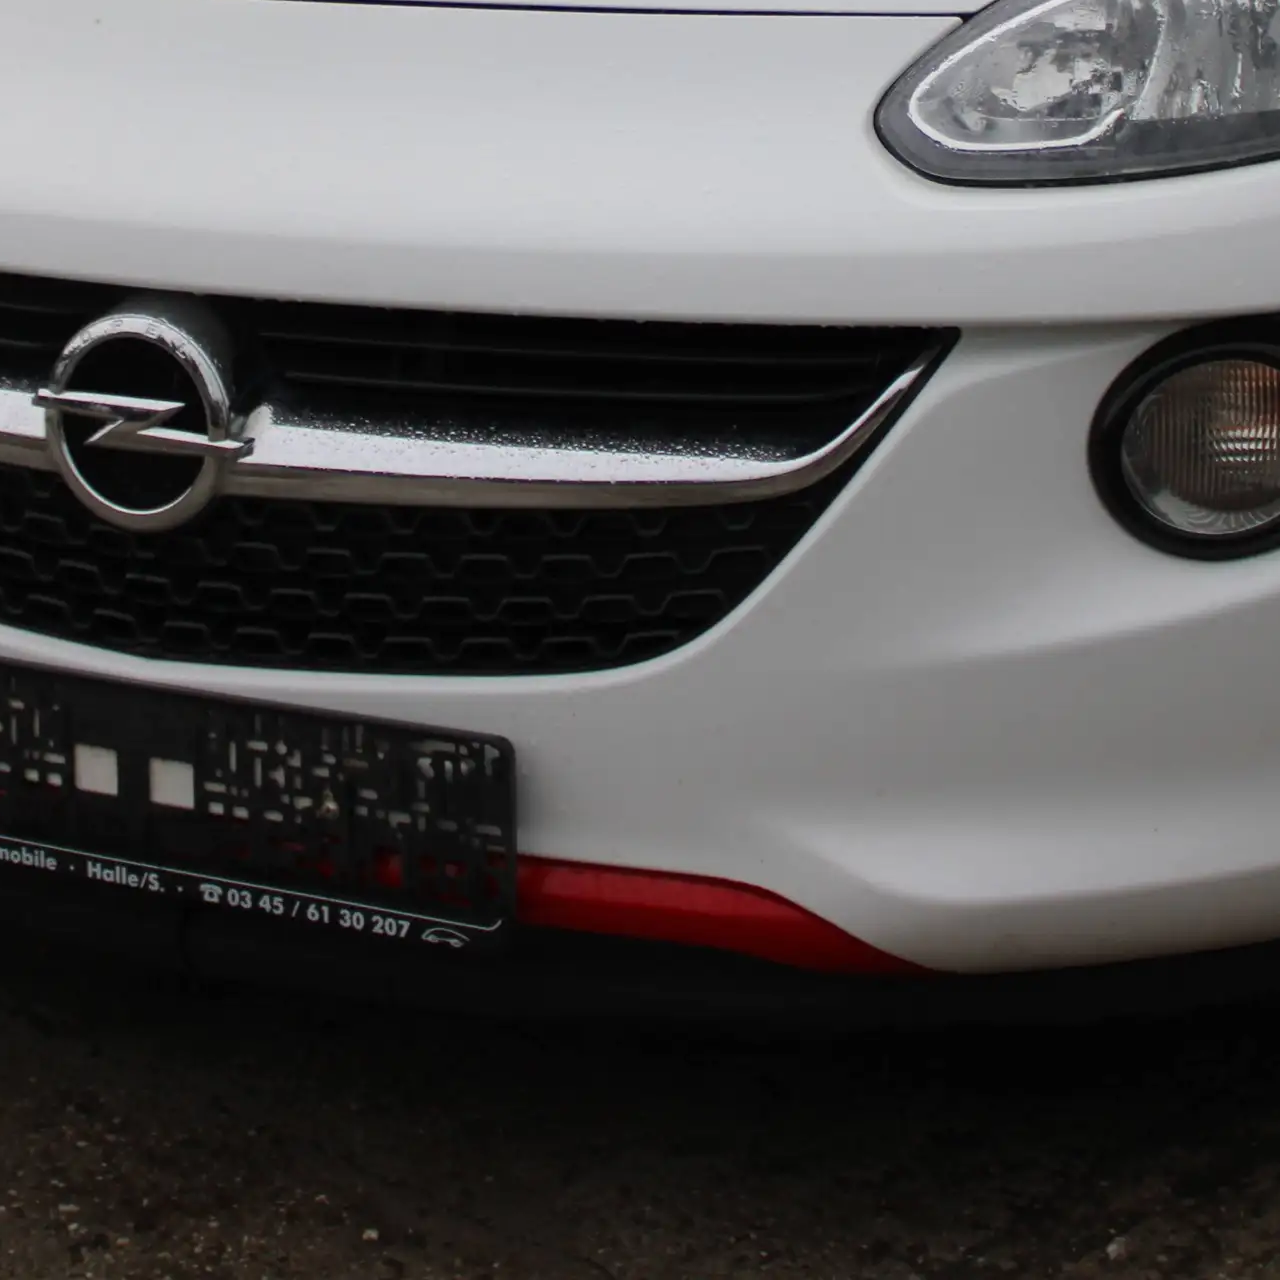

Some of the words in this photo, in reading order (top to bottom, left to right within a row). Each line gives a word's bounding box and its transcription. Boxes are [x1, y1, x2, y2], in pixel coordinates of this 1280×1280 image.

[227, 888, 253, 909] 03
[258, 895, 285, 916] 45
[307, 903, 329, 924] 61
[339, 909, 366, 931] 30
[371, 915, 412, 939] 207
